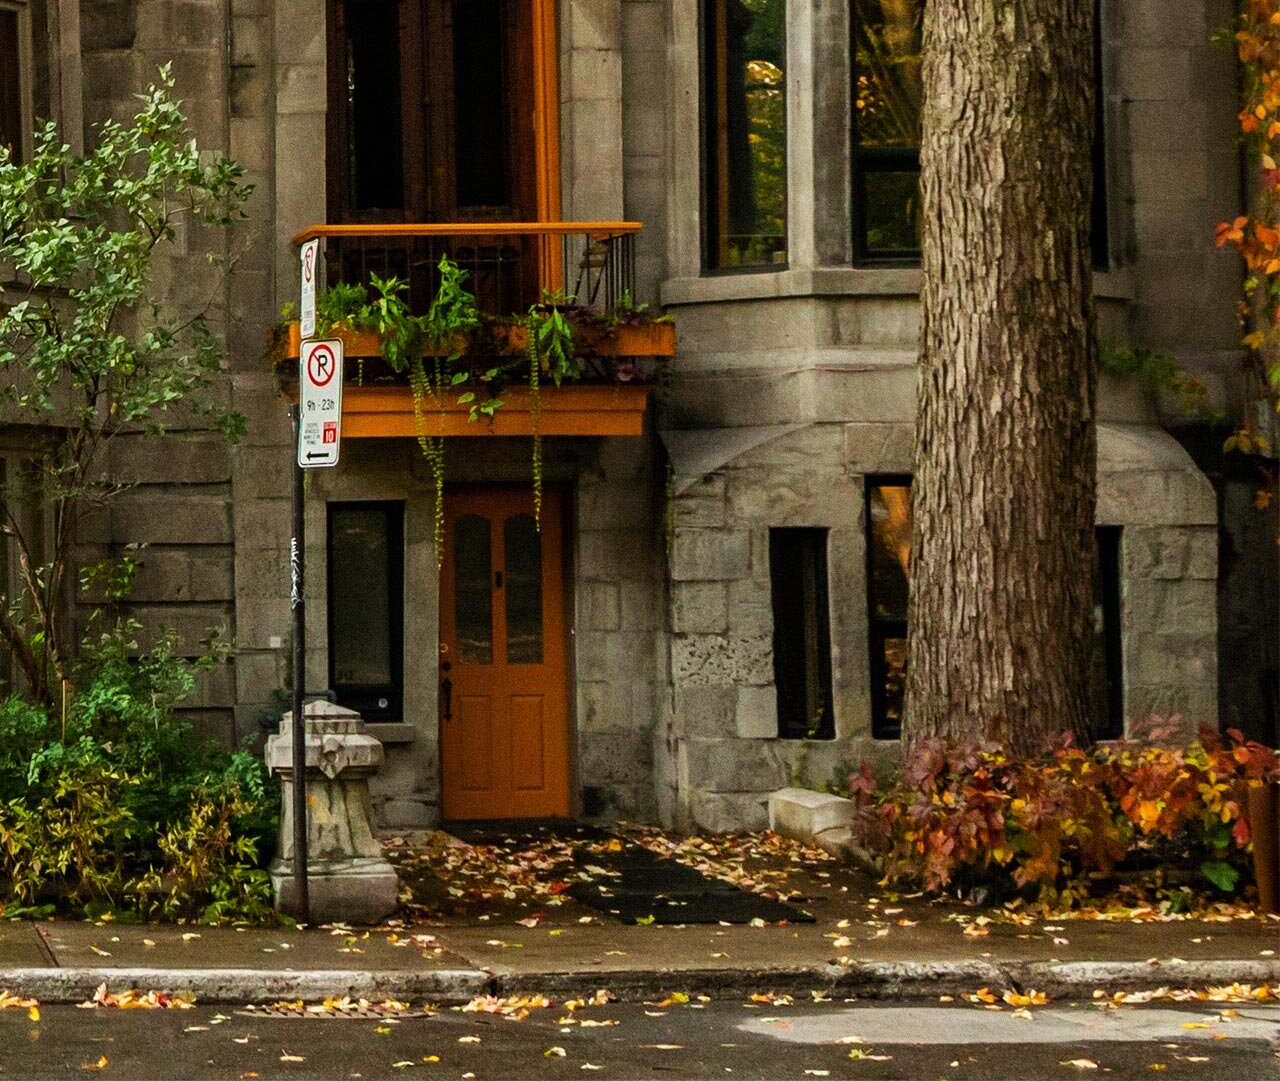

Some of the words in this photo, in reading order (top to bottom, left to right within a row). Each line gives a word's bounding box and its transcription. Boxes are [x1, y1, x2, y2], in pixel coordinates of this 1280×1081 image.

[318, 355, 328, 376] P
[306, 400, 316, 411] 9h
[321, 399, 335, 411] 23h
[325, 430, 334, 443] 10
